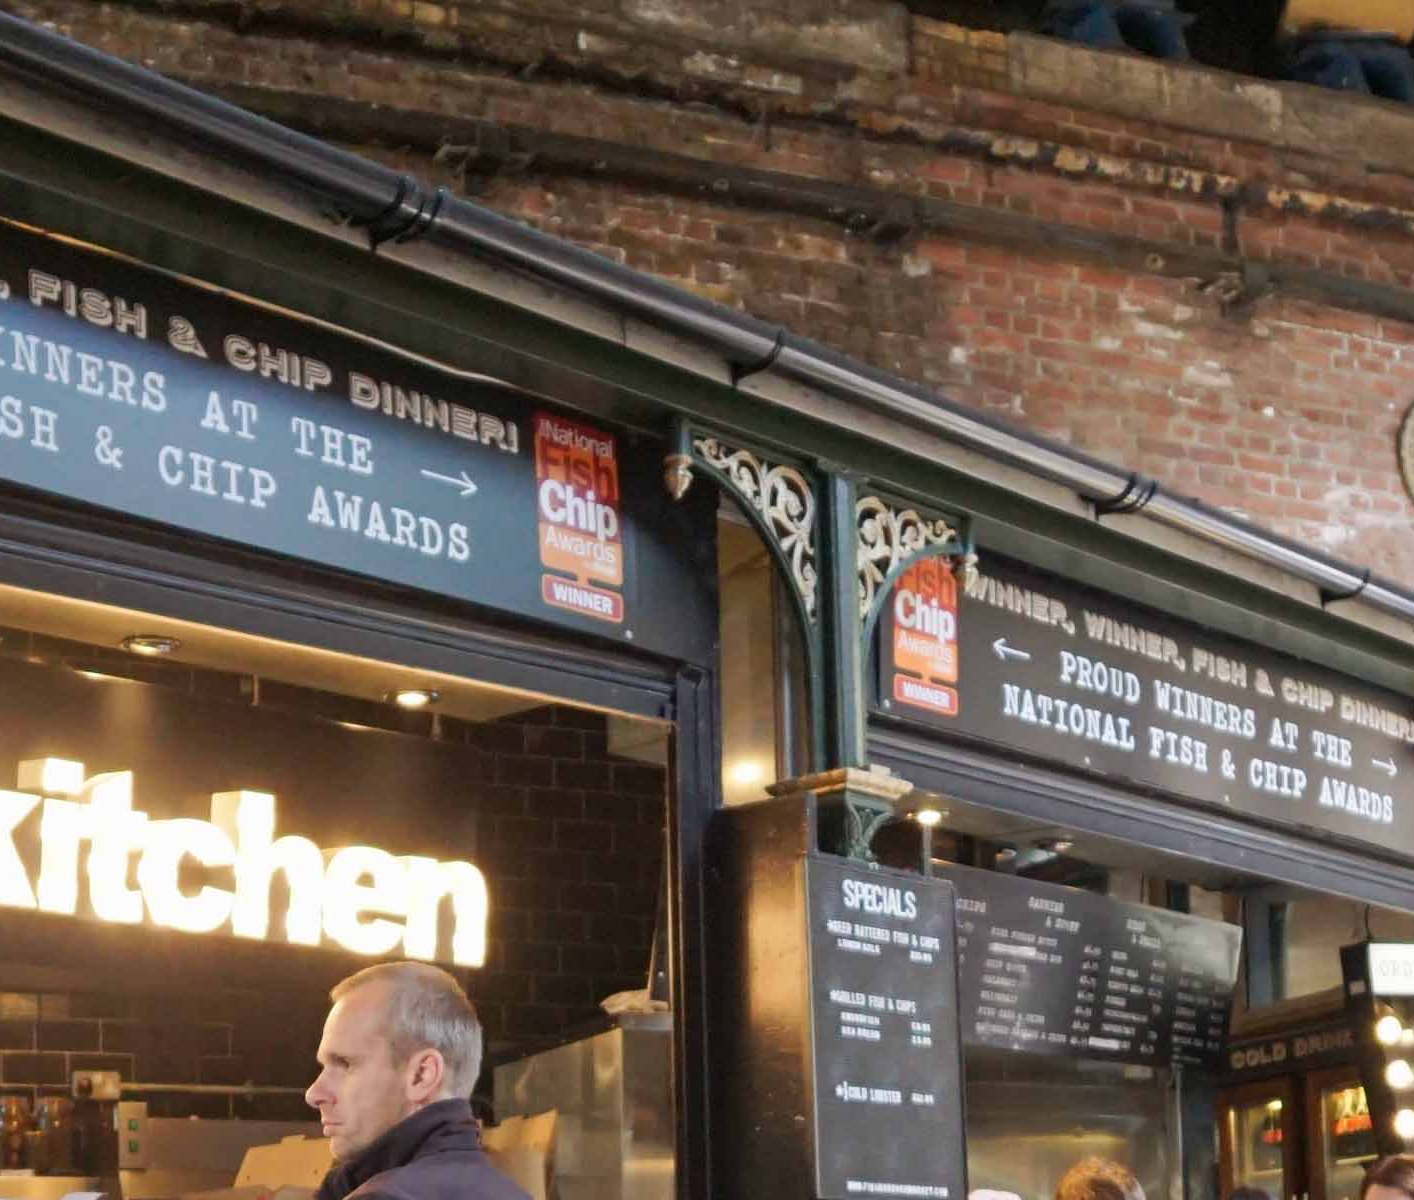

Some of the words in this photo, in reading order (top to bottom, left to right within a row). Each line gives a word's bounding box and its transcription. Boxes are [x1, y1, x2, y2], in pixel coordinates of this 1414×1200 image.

[28, 269, 148, 339] FISH
[168, 317, 208, 359] &
[224, 334, 332, 391] CHIP
[349, 372, 518, 454] DINNER!
[200, 392, 258, 440] AT
[291, 417, 374, 475] THE
[95, 424, 123, 471] &
[158, 446, 277, 508] CHIP
[308, 487, 471, 562] AWARDS
[539, 479, 618, 540] Chip
[546, 526, 616, 563] Awards
[553, 582, 613, 615] WINNER
[895, 589, 955, 643] Chip
[1059, 650, 1141, 704] PROUD
[1154, 679, 1256, 738] WINNERS
[1270, 717, 1299, 750] AT
[1312, 730, 1352, 767] THE
[1193, 647, 1247, 688] FISH
[1281, 677, 1334, 712] CHIP
[1002, 683, 1135, 750] NATIONAL
[1149, 726, 1208, 772] FISH
[1221, 749, 1236, 779] &
[1250, 758, 1307, 797] CHIP
[1319, 776, 1393, 823] AWARDS
[842, 879, 918, 919] SPECIALS
[1230, 1043, 1286, 1070] COLD
